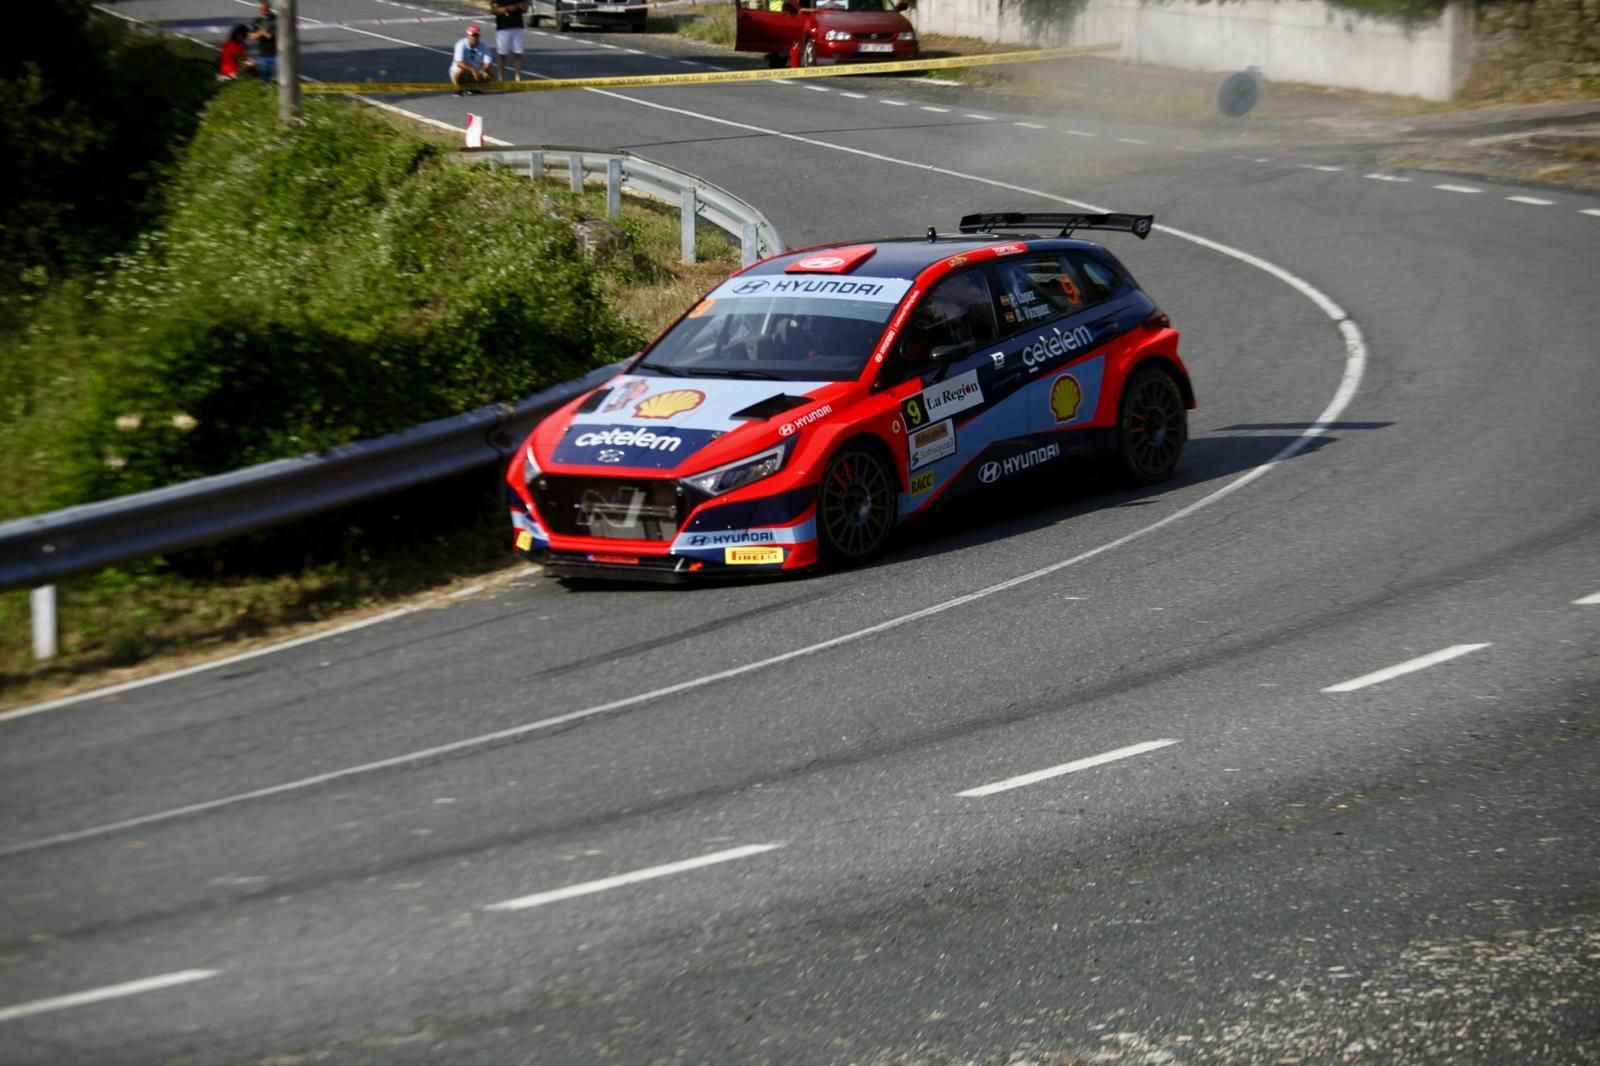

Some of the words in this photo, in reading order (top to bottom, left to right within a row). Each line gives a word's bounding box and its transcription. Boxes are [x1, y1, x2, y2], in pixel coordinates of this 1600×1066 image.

[772, 280, 884, 296] HYUNDAI
[1060, 272, 1080, 305] 9
[794, 404, 833, 428] HYUNDAI
[907, 400, 922, 425] 9
[926, 397, 942, 411] La
[574, 427, 682, 452] cetelem
[1002, 442, 1060, 475] HYUNDAI
[911, 473, 932, 494] RACC
[712, 532, 774, 544] HYUNDAI
